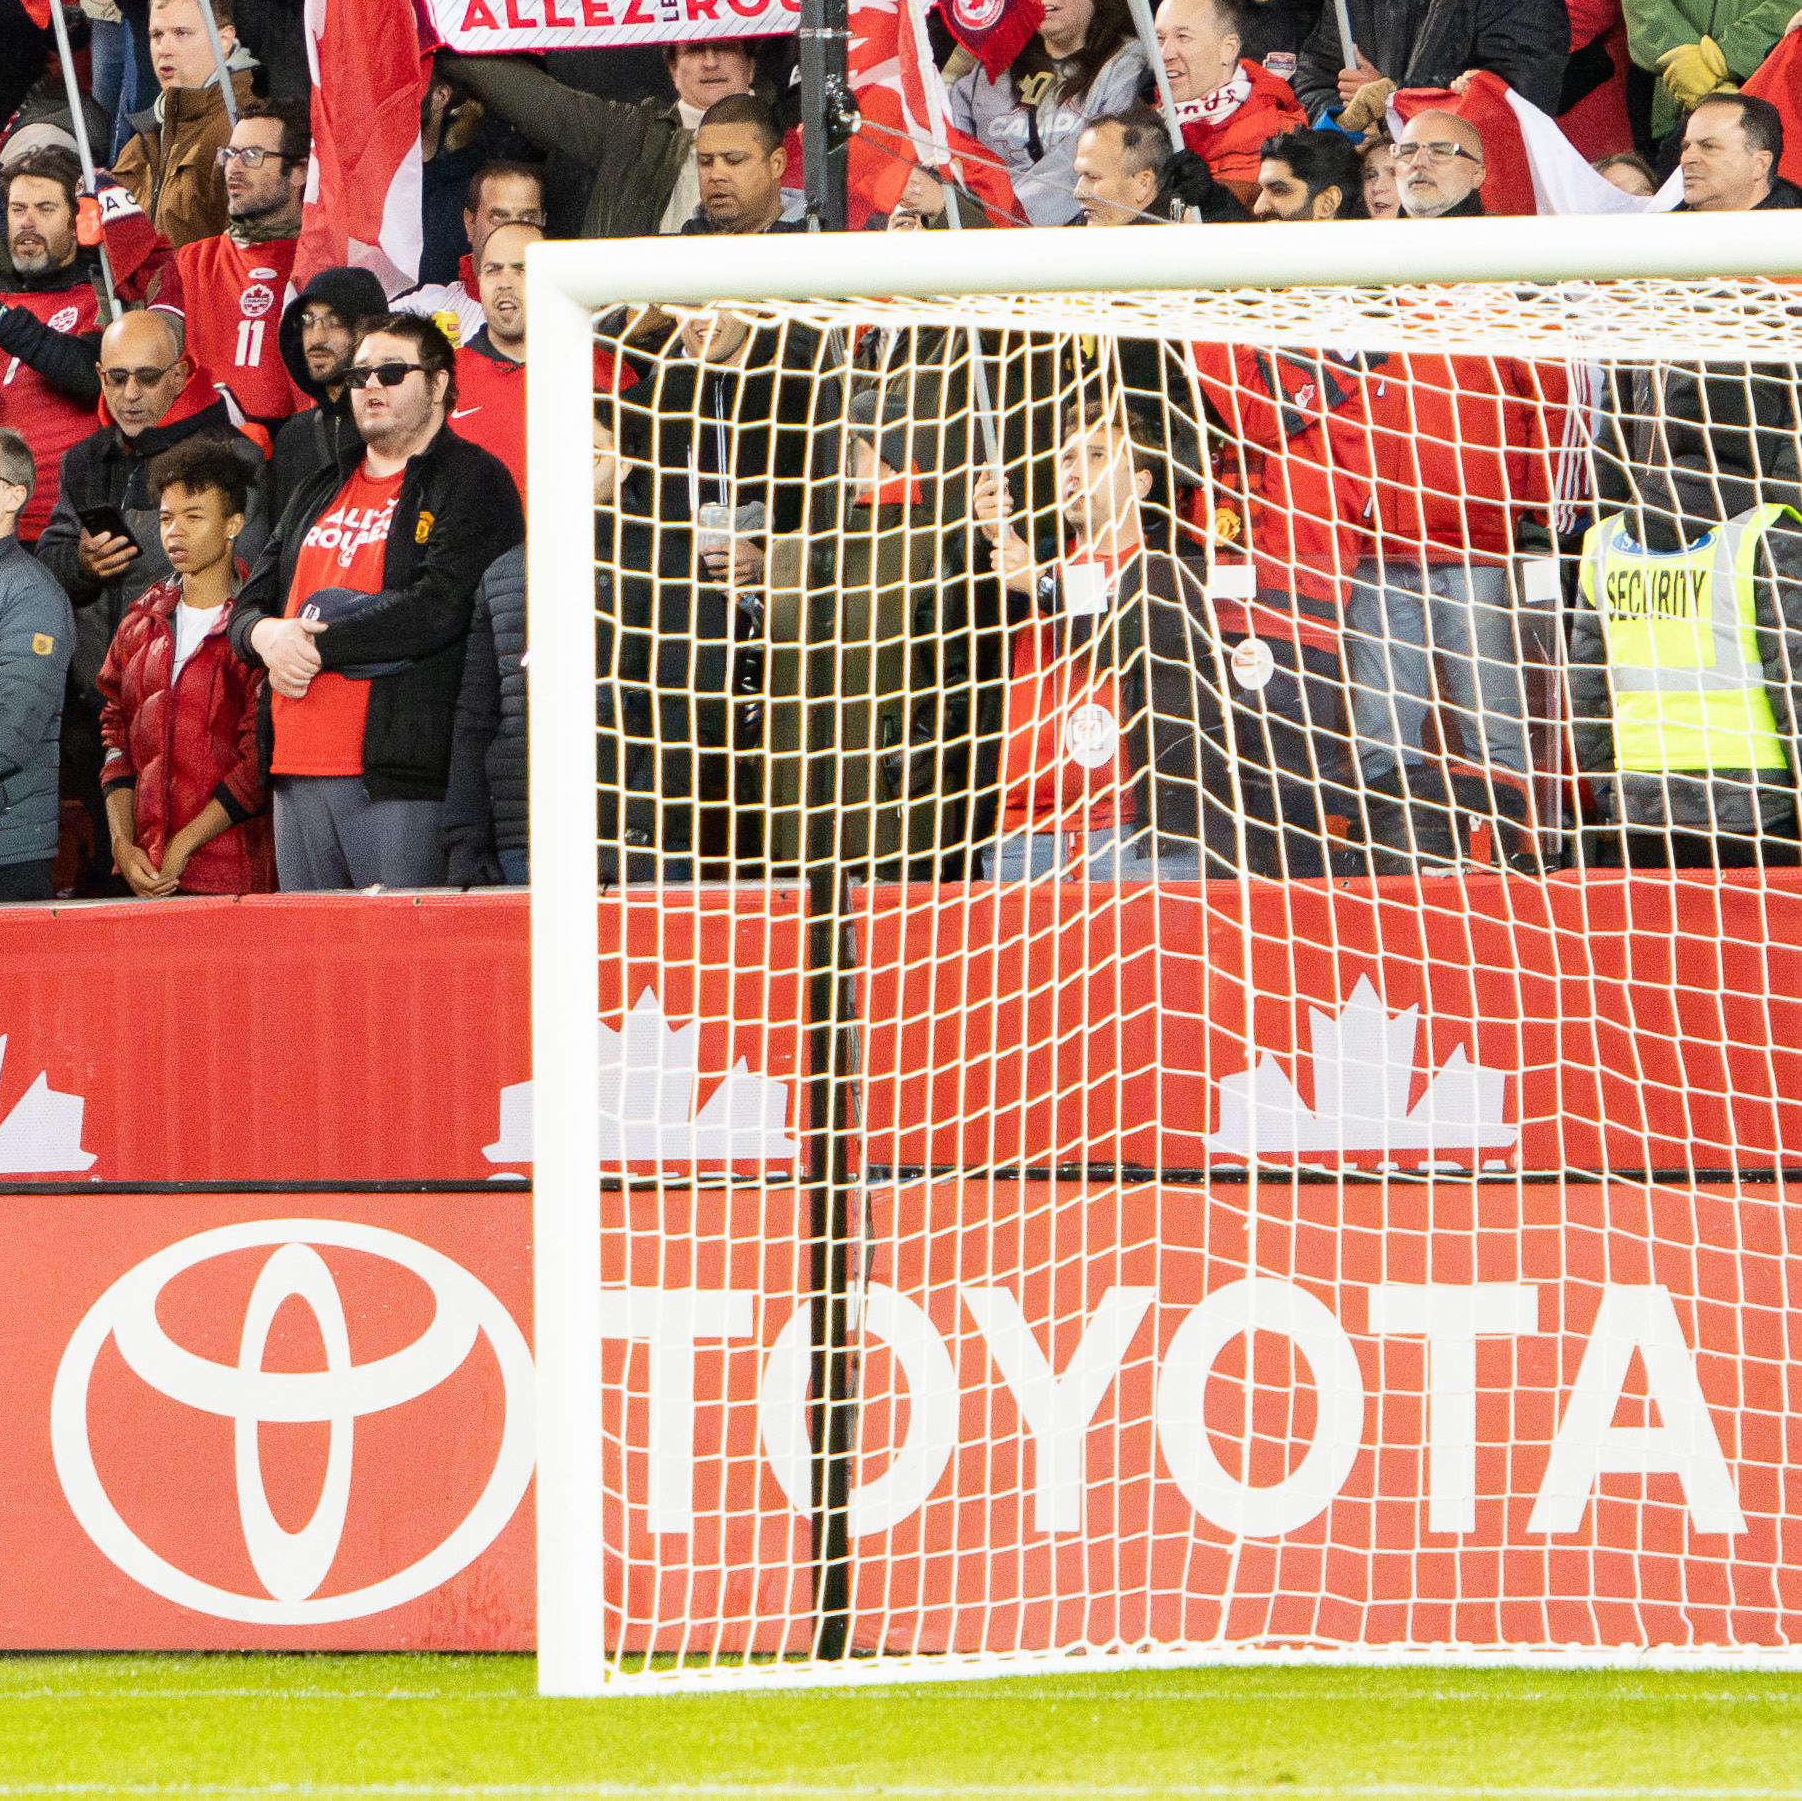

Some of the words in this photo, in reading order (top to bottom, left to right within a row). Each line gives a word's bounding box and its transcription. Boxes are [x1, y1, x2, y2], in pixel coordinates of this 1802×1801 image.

[986, 111, 1087, 138] CAADA
[237, 319, 266, 367] 11
[1605, 568, 1703, 620] SECURITY
[600, 1278, 1748, 1537] TOYOTA
